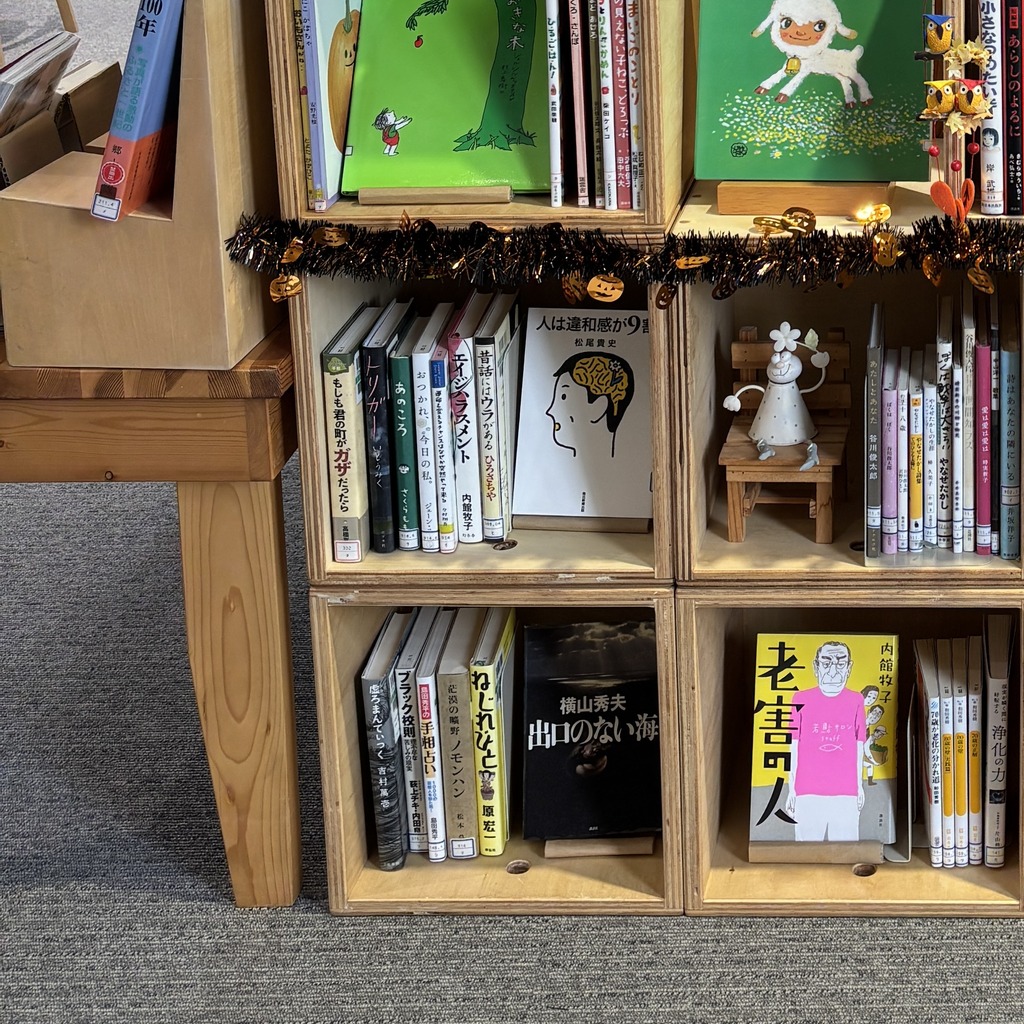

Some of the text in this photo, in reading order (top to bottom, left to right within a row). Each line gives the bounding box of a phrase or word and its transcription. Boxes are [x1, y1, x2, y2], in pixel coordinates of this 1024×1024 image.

[627, 0, 640, 106] まいごのことり
[1008, 34, 1020, 137] あらしのよるに
[986, 164, 995, 173] 岸
[574, 338, 617, 348] 松尾貴史
[365, 355, 386, 438] トリガー
[395, 382, 408, 437] あのころ
[451, 353, 473, 464] エイジハラスメント
[477, 350, 494, 451] 昔話にはウラがある
[869, 360, 878, 424] あたしとあなた
[332, 378, 351, 513] もしも君の町がガザだったら
[886, 422, 893, 432] ぼく
[981, 406, 989, 452] 愛は愛は愛は
[1006, 374, 1016, 481] 詩はあなたの隣にいる
[372, 445, 383, 488] いとうみく
[484, 455, 497, 501] ひろさちや
[869, 434, 878, 480] 谷川俊太郎
[939, 458, 949, 510] やなせたかし
[461, 494, 473, 531] 内館牧子
[1007, 508, 1015, 543] 井坂洋子
[879, 642, 894, 704] 内館牧子
[369, 684, 387, 760] 虚ろまんてぃっく
[398, 671, 416, 738] ブラック校則
[421, 685, 430, 719] 島田秀平の
[471, 671, 497, 769] ねじれびと
[559, 693, 627, 714] 横山秀夫
[420, 720, 437, 776] 手相占い
[527, 713, 660, 751] 出口のない海
[754, 641, 806, 827] 老害の人
[931, 711, 940, 784] 70歳が老化の分かれ道
[991, 725, 1007, 783] 浄化の力
[450, 740, 466, 798] ノモンハン
[430, 817, 438, 840] 島田秀平
[482, 805, 496, 840] 原宏一
